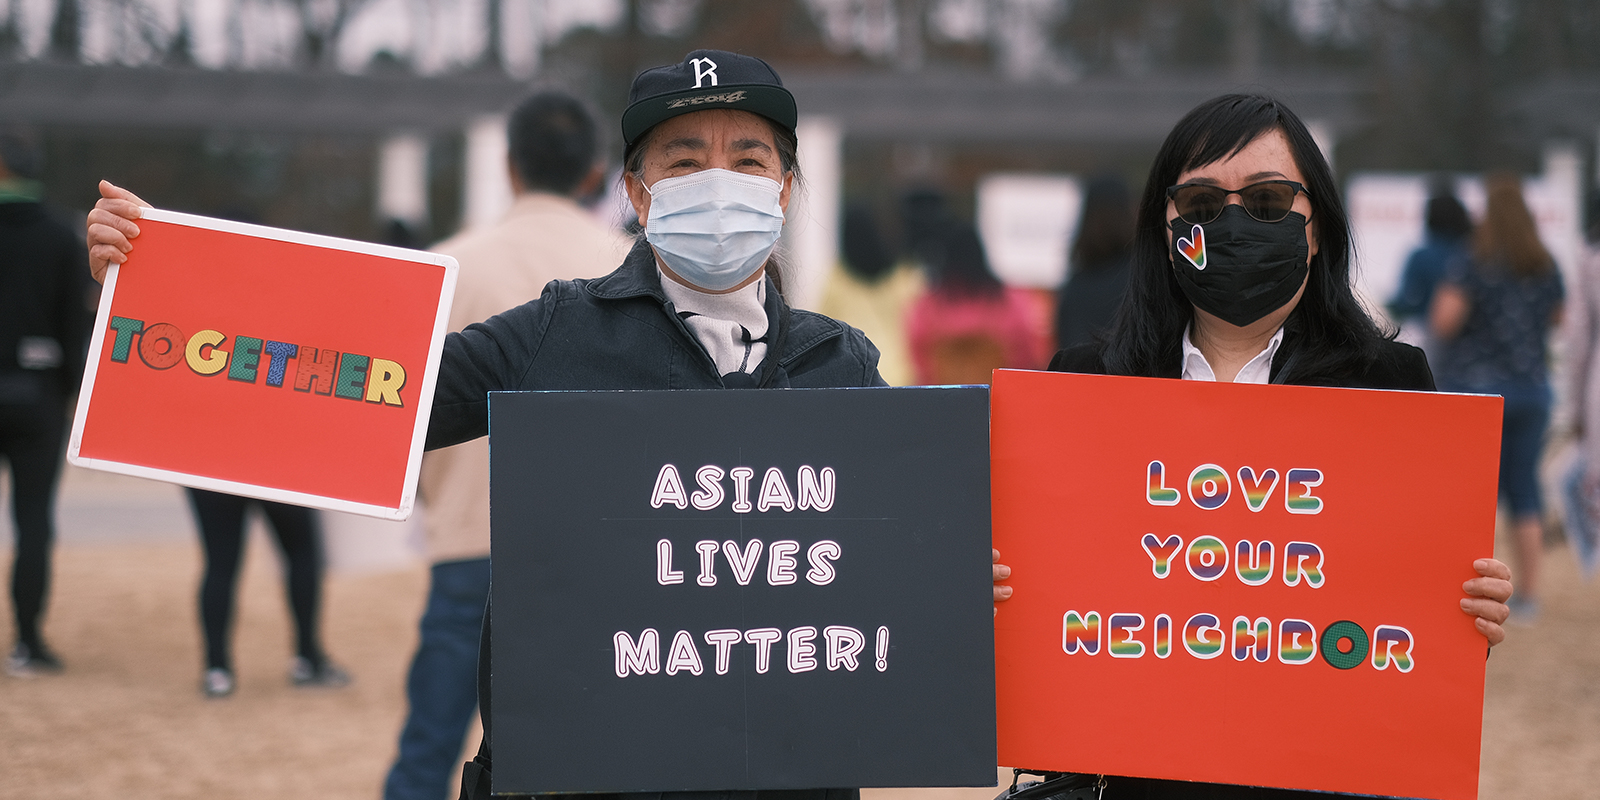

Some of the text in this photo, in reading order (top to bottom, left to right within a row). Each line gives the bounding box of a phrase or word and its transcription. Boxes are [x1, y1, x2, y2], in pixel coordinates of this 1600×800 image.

[689, 57, 717, 89] R
[110, 315, 404, 408] TOGETHER
[650, 464, 836, 513] ASIAN
[1146, 460, 1325, 515] LOVE
[657, 539, 841, 587] LIVES
[1141, 533, 1326, 589] YOUR
[614, 626, 890, 678] MATTER!
[1063, 610, 1415, 674] NEIGHBOR
